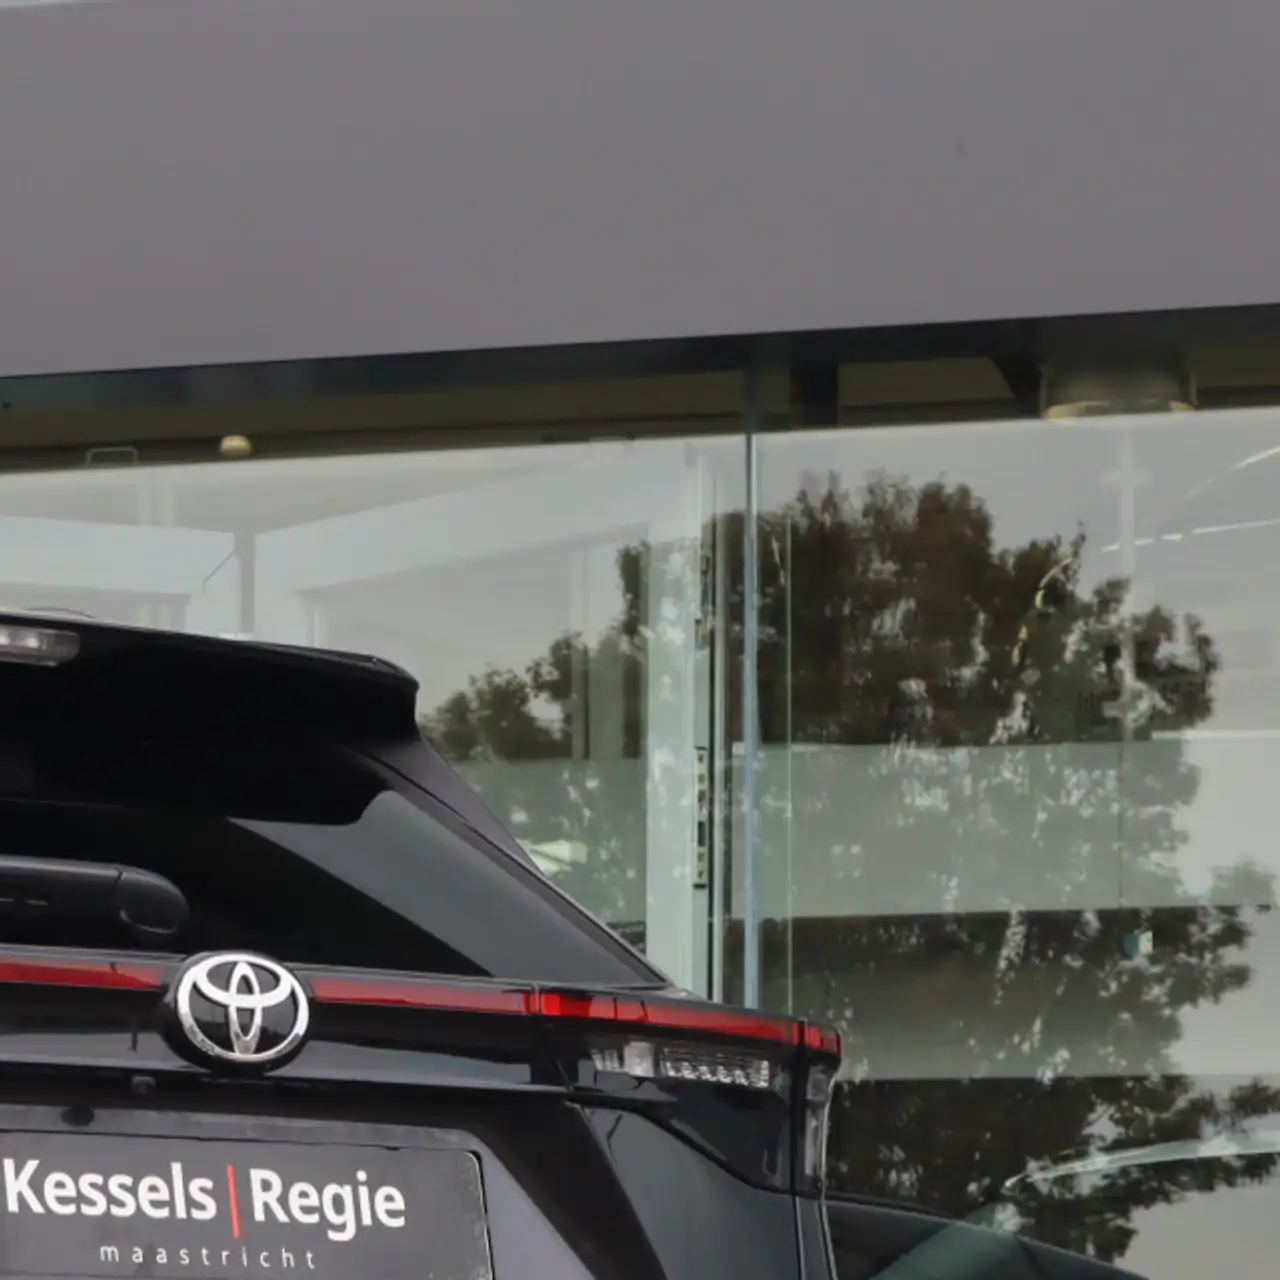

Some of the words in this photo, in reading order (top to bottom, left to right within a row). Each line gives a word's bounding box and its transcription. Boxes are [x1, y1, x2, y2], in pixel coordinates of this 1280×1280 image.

[2, 1157, 218, 1221] Kessels
[250, 1168, 406, 1242] Regie
[99, 1239, 317, 1270] maastricht
